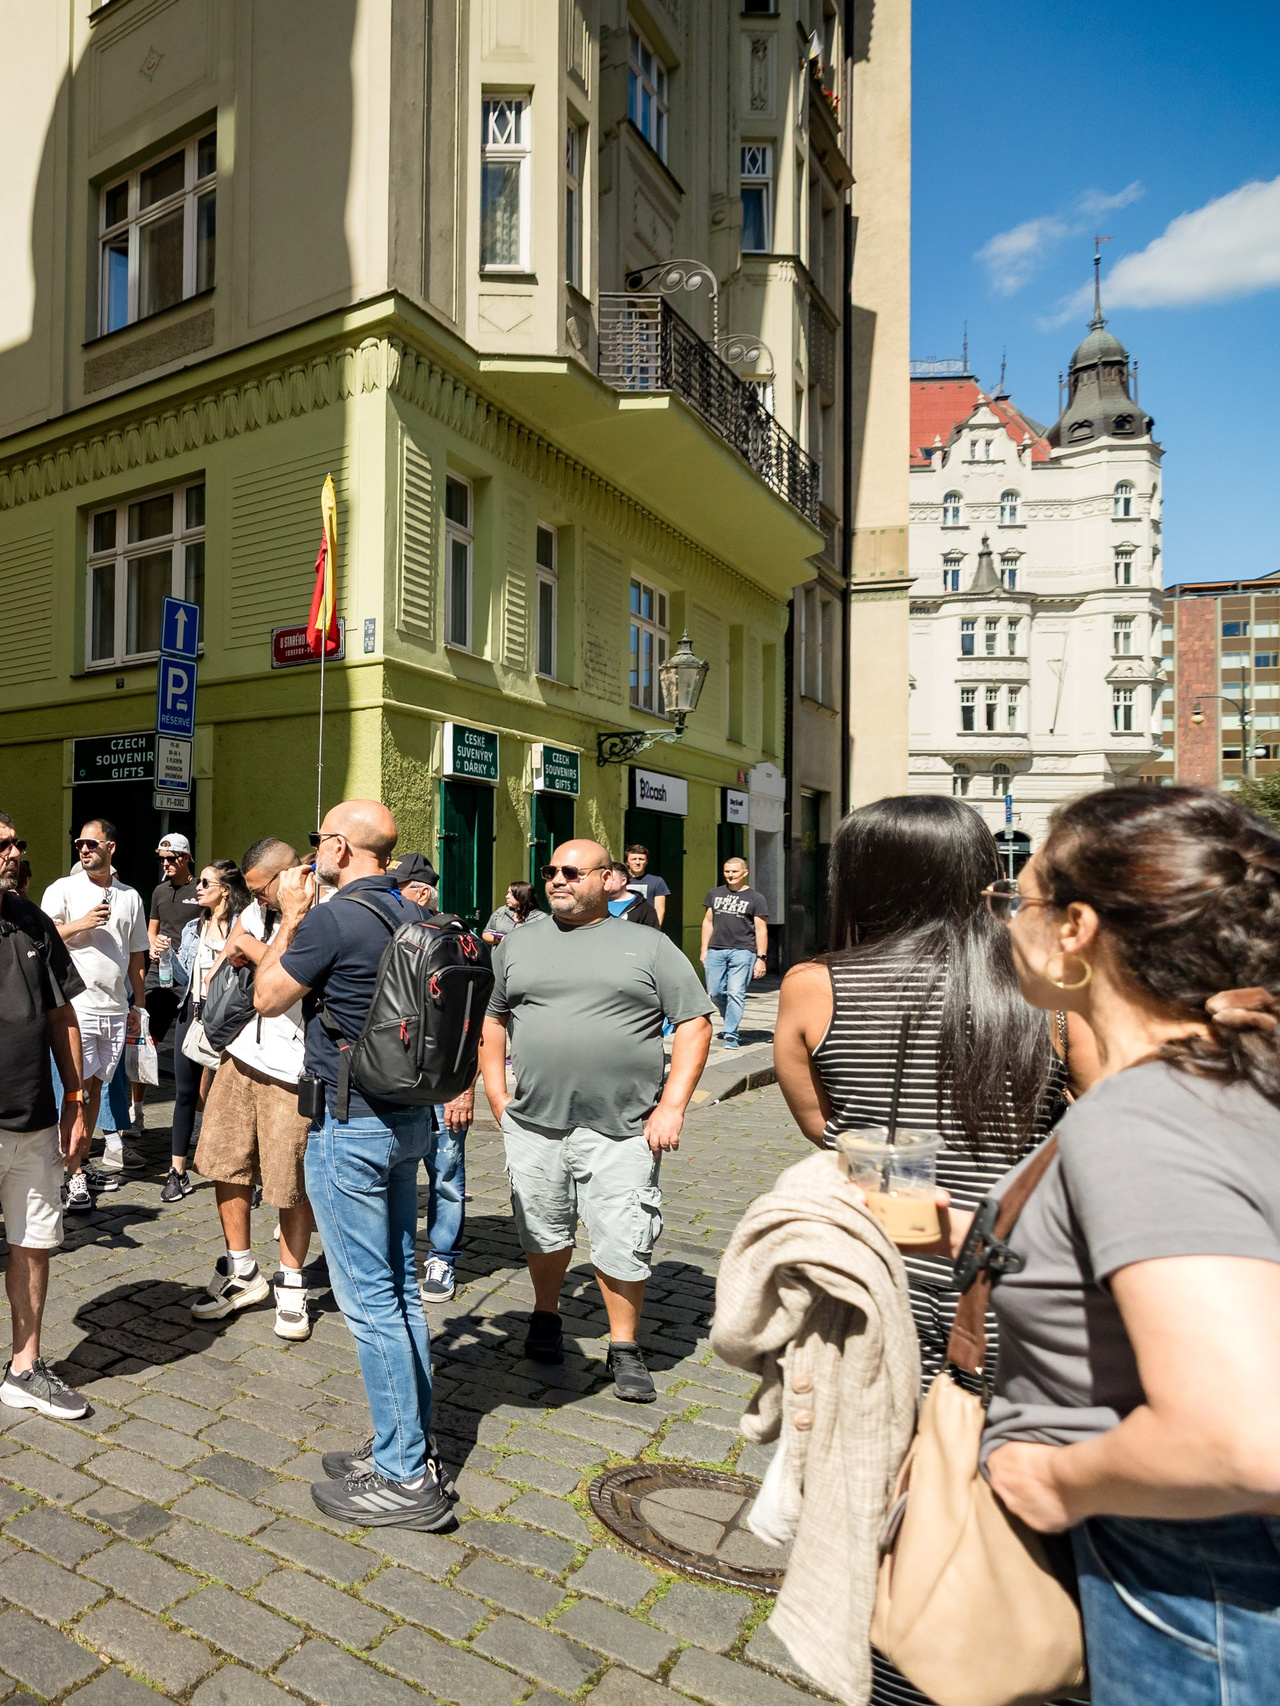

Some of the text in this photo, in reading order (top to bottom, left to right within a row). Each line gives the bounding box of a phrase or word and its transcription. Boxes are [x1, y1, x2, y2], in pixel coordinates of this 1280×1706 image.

[284, 632, 306, 648] STARÉHO
[167, 666, 189, 709] P
[161, 713, 191, 727] RÉSERVÉ
[111, 737, 146, 750] CZECH
[464, 731, 486, 748] ČESKÉ
[96, 751, 154, 766] SOUVENIR
[457, 745, 494, 763] SUVENÝRY
[552, 752, 570, 765] CZECH
[111, 766, 144, 778] GIFTS
[464, 759, 487, 775] DÁRKY
[545, 763, 577, 779] SOUVENIRS
[554, 778, 571, 791] GIFTS
[713, 896, 750, 914] UTAH
